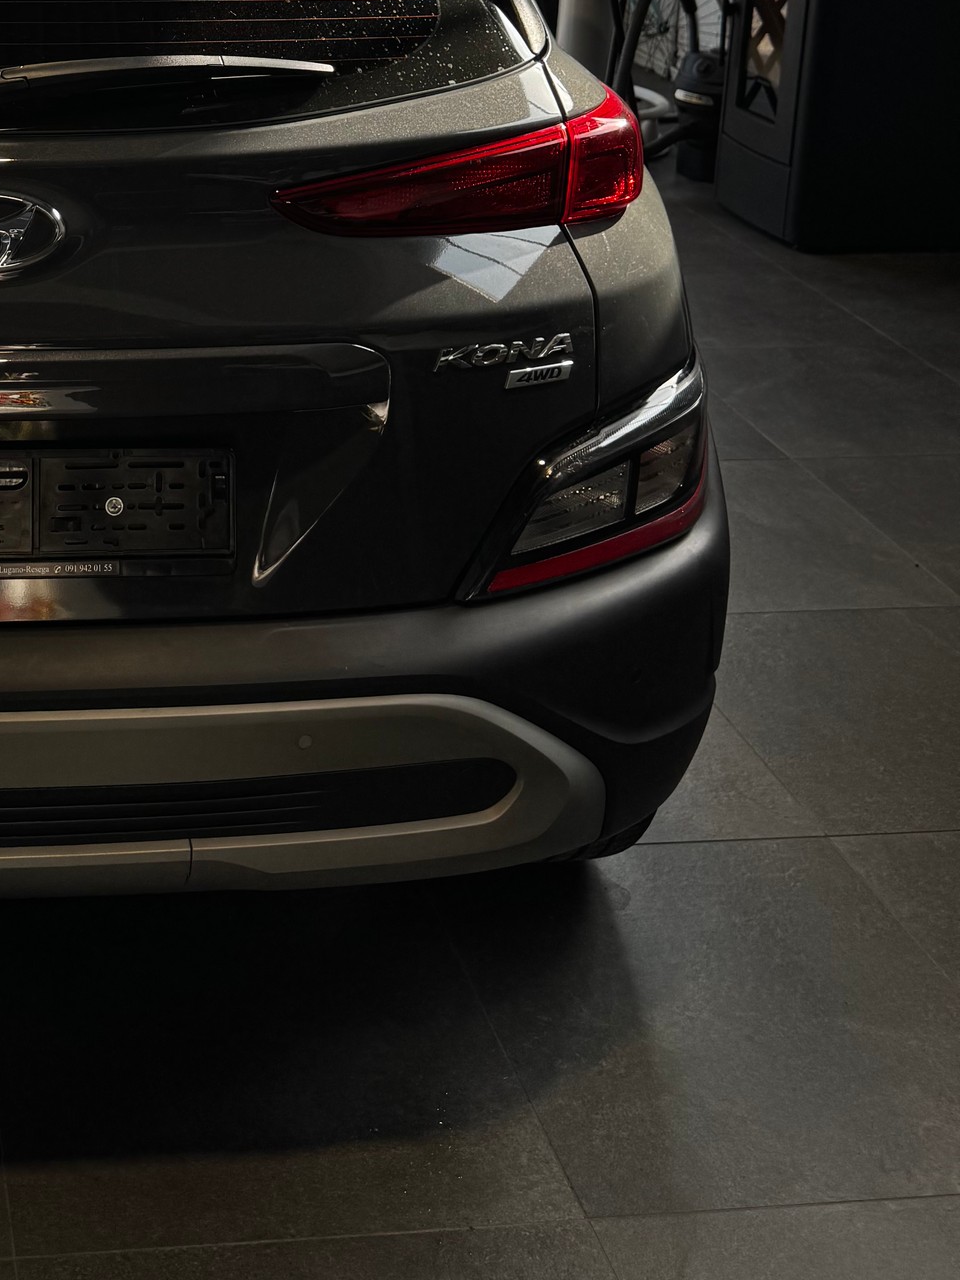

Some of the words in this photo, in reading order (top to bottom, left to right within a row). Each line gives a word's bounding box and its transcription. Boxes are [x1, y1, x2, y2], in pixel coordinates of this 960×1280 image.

[432, 332, 574, 373] KONA
[515, 366, 562, 384] 4WD
[64, 564, 78, 574] 091
[78, 564, 92, 573] 942
[93, 563, 102, 573] 01
[103, 563, 113, 572] 55
